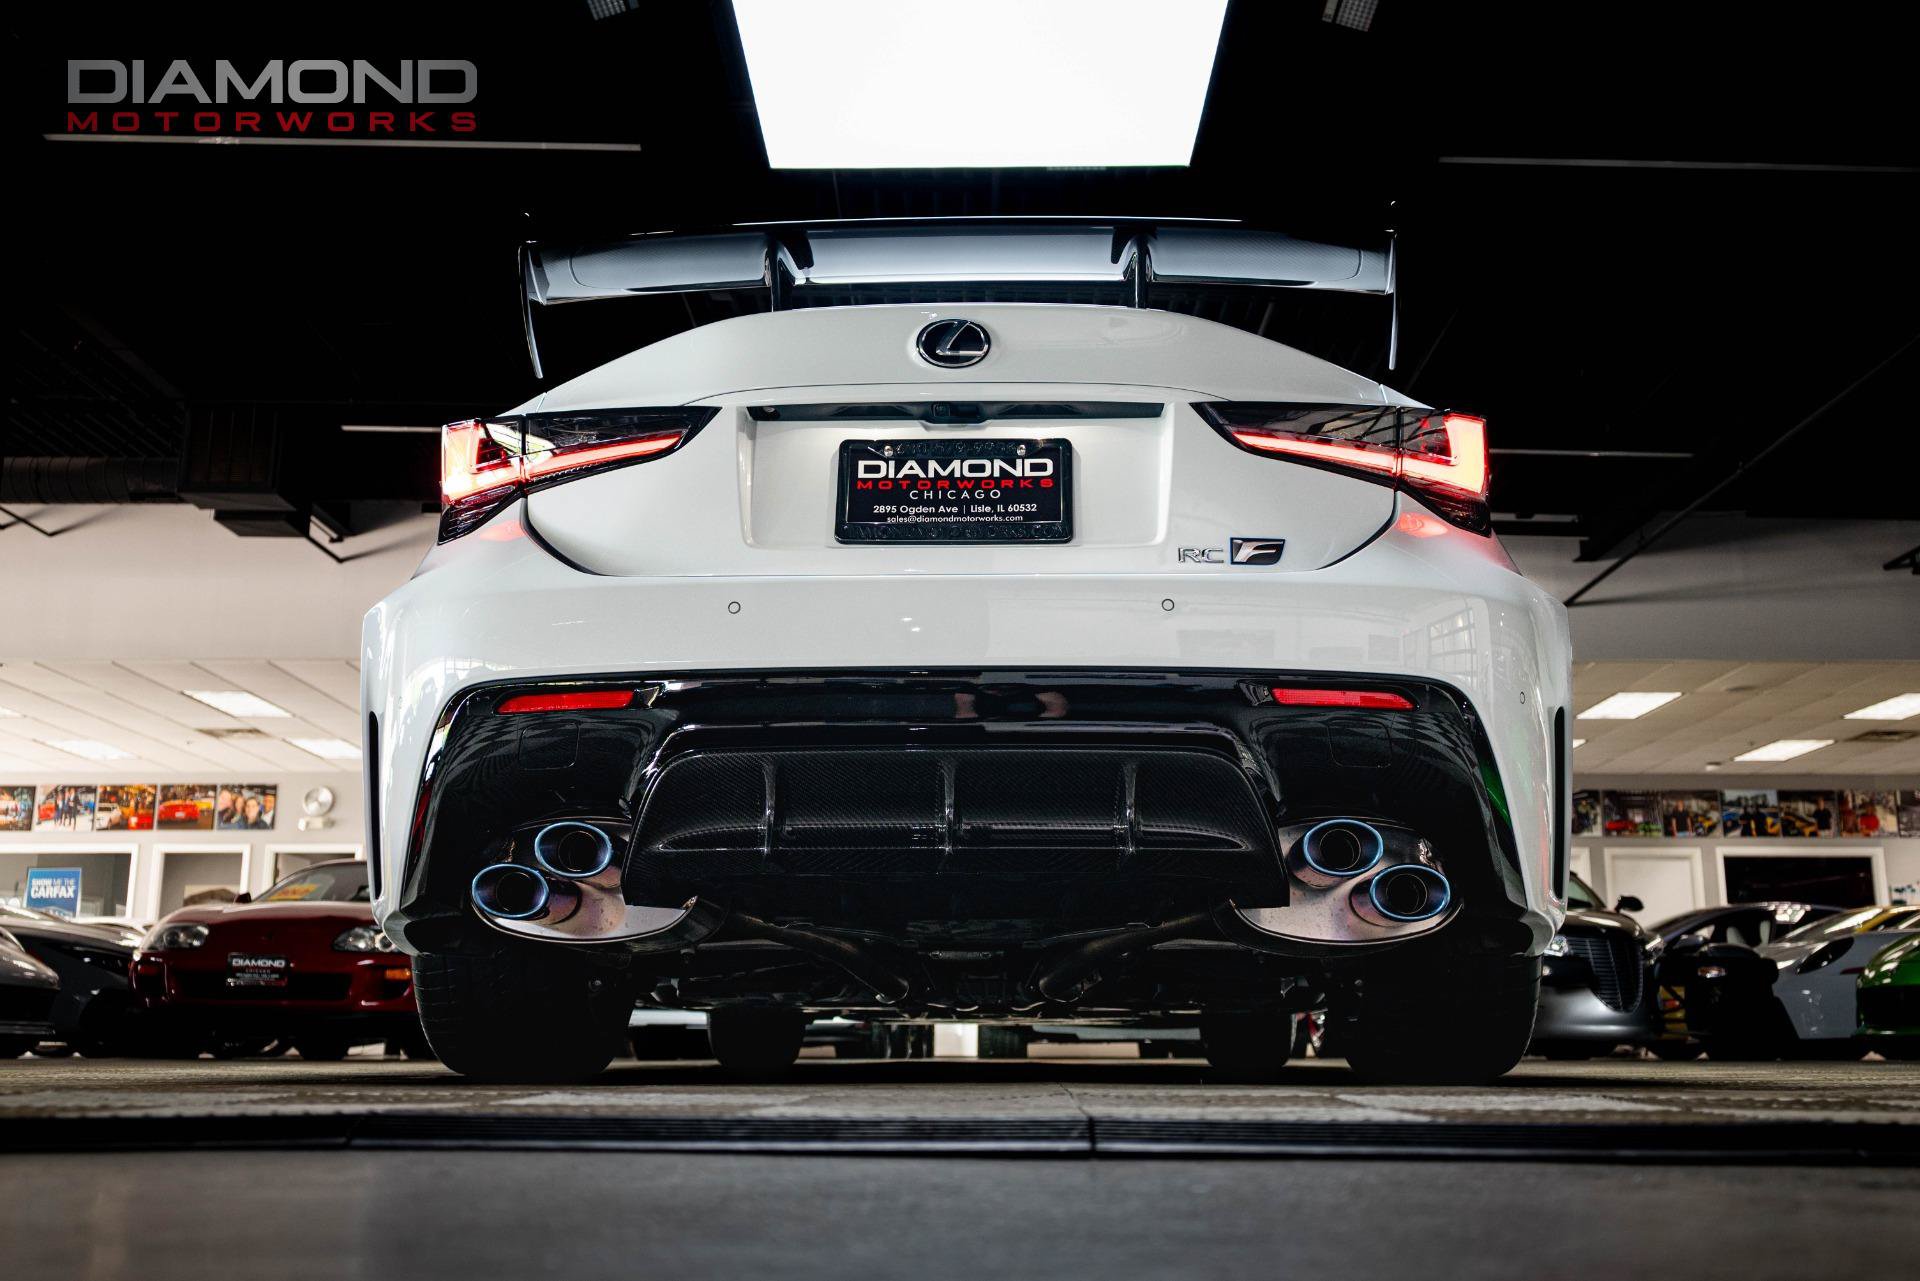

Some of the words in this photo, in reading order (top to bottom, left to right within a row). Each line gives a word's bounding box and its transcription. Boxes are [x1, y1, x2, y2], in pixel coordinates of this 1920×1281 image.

[857, 458, 1054, 479] DIAMOND
[856, 478, 1055, 490] MOTORWORKS
[909, 489, 1001, 500] CHICAGO
[873, 505, 898, 514] 2895
[899, 504, 936, 515] Ogden
[937, 504, 959, 513] Ave
[970, 504, 995, 514] Lisle,
[997, 504, 1006, 513] IL
[1007, 503, 1038, 513] 60532
[886, 514, 1024, 523] sales@diamondmotorworks.com
[1177, 547, 1225, 564] RC
[30, 885, 75, 899] CARFAX
[232, 958, 286, 968] DIAMOND
